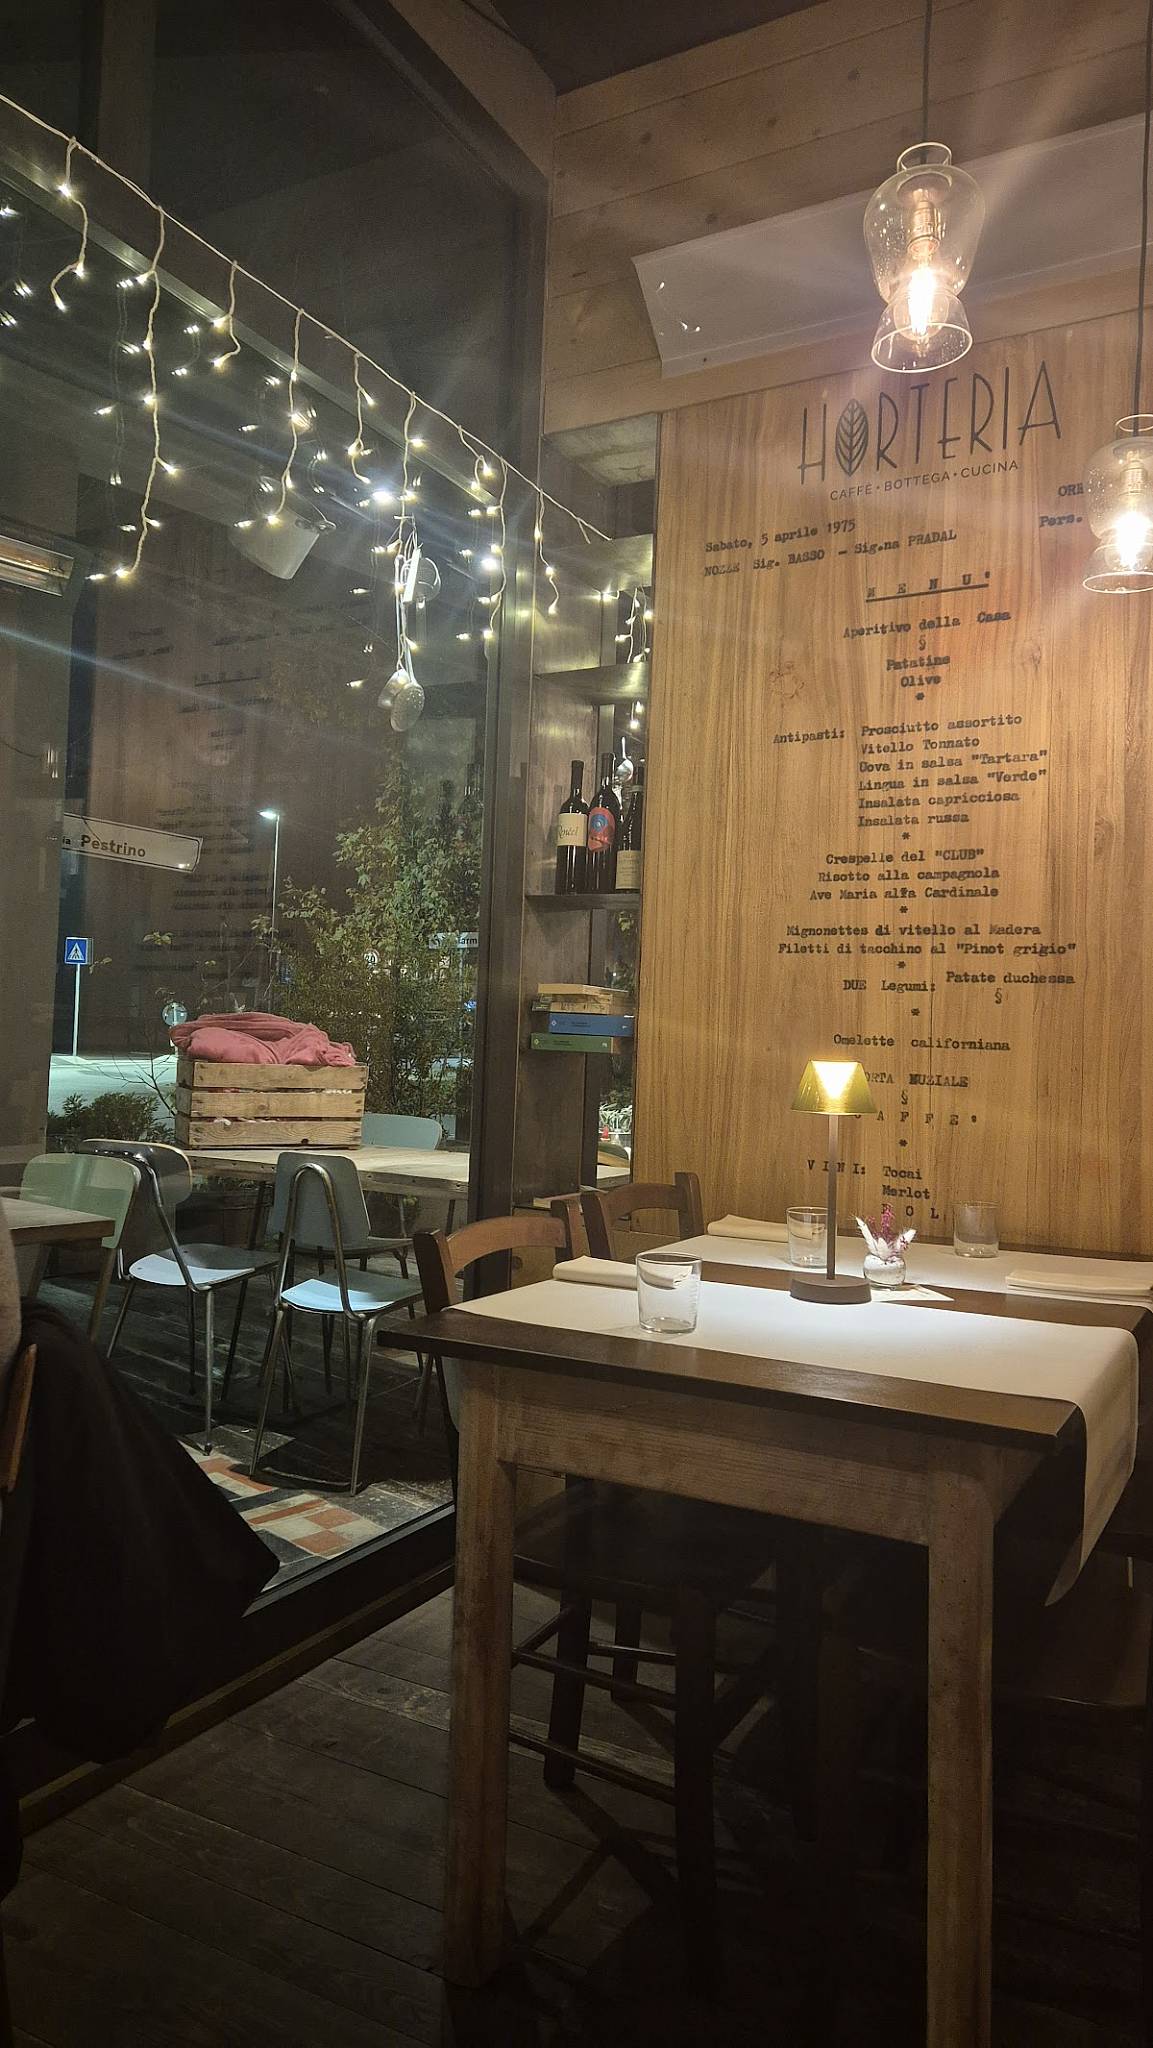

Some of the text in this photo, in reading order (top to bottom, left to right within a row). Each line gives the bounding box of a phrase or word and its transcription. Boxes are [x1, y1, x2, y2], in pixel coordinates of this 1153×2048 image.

[797, 360, 1062, 484] HORTERIA
[884, 472, 951, 492] BOTTEGA
[960, 460, 1019, 479] CUCINA
[705, 519, 856, 553] Sabato, 5 aprile 1975
[752, 559, 780, 570] Sig.
[787, 549, 825, 565] BASSO
[854, 541, 900, 555] Sig.na
[908, 530, 957, 547] PRADAL
[843, 610, 1011, 638] Aperitivo della Casa
[886, 655, 950, 671] Patatine
[901, 674, 941, 687] Olive
[773, 714, 1022, 743] Antipasti: Prosciutto assortito
[861, 737, 980, 754] Vitello Tonnato
[897, 760, 914, 771] in
[921, 757, 963, 769] salsa
[971, 750, 1047, 765] "Tartara"
[858, 769, 1047, 792] Lingua in salsa "Verde"
[858, 790, 1020, 809] Insalata capricciosa
[857, 811, 969, 827] Insalata russa
[80, 834, 146, 858] Pestrino
[825, 848, 985, 866] Crespelle del "CLUB"
[818, 867, 1000, 883] Risotto alla campagnola
[809, 890, 832, 901] Ave
[839, 888, 878, 900] Maria
[924, 886, 999, 898] Cardinale
[786, 924, 1041, 938] Mignonettes di vitello al Madera
[778, 943, 1077, 957] Filetti di tacchino al "Pinot grigio"
[843, 971, 1075, 993] DUE Legumi: Patate duchessa
[834, 1034, 1011, 1051] Omelette californiana
[866, 1072, 895, 1084] ORTA
[883, 1166, 923, 1180] Tocai
[882, 1185, 930, 1199] Merlot
